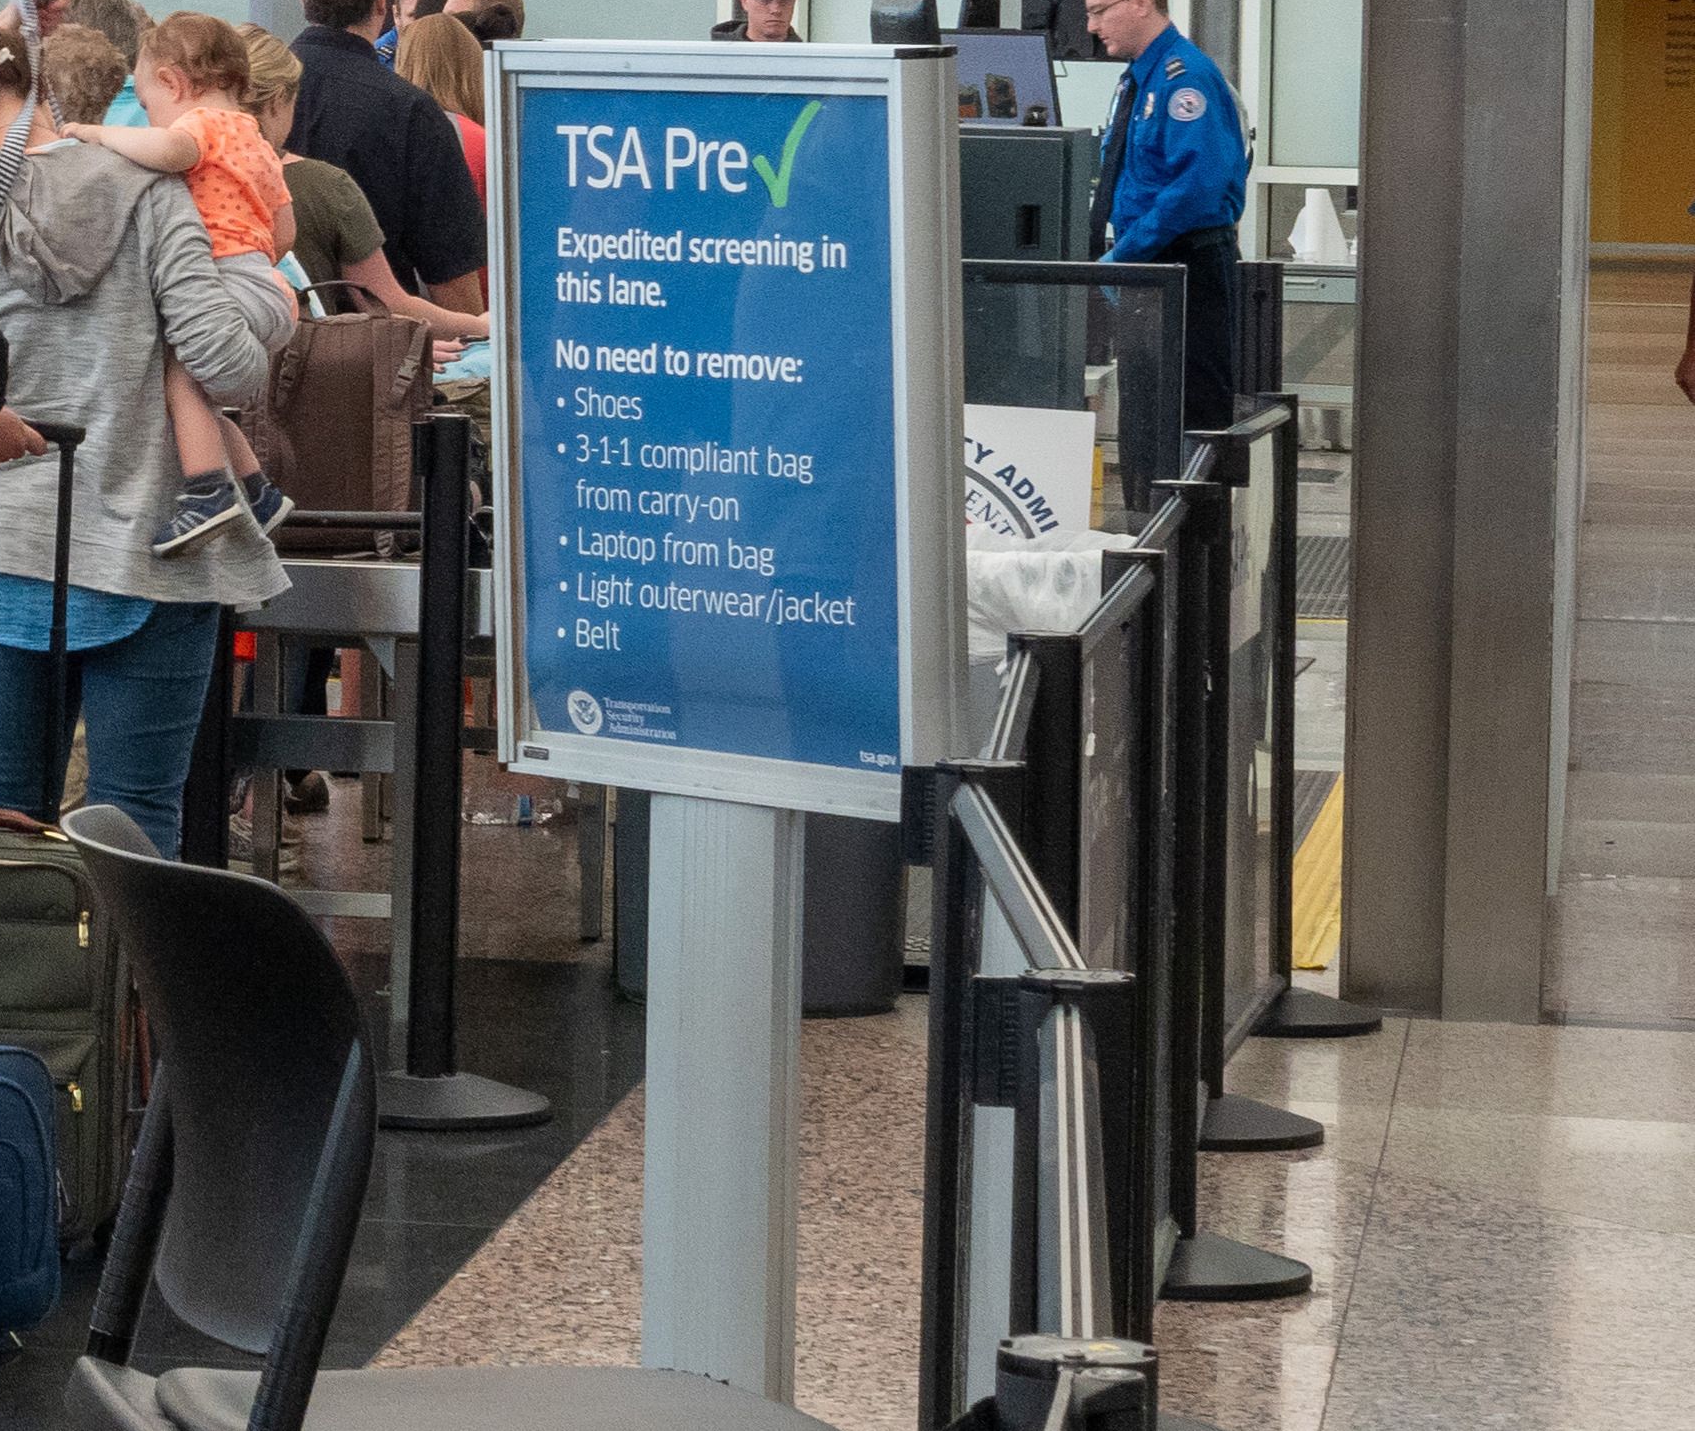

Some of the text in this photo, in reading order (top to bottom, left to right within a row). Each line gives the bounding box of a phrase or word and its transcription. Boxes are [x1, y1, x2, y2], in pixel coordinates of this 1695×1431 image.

[555, 124, 748, 194] TSA Pre
[557, 227, 847, 274] Expedited screening in
[556, 272, 667, 306] this lane.
[555, 339, 804, 383] No need to remove:
[574, 387, 643, 421] Shoes
[576, 434, 814, 484] 3-1-1 compliant bag
[576, 479, 740, 523] from carry-on
[577, 527, 776, 577] Laptop from bag
[577, 572, 856, 626] Light outerwear/jacket
[575, 618, 622, 651] Belt
[603, 696, 672, 716] Transportation
[606, 710, 645, 727] Security
[607, 721, 677, 741] Administration
[858, 750, 898, 769] tsa.gov
